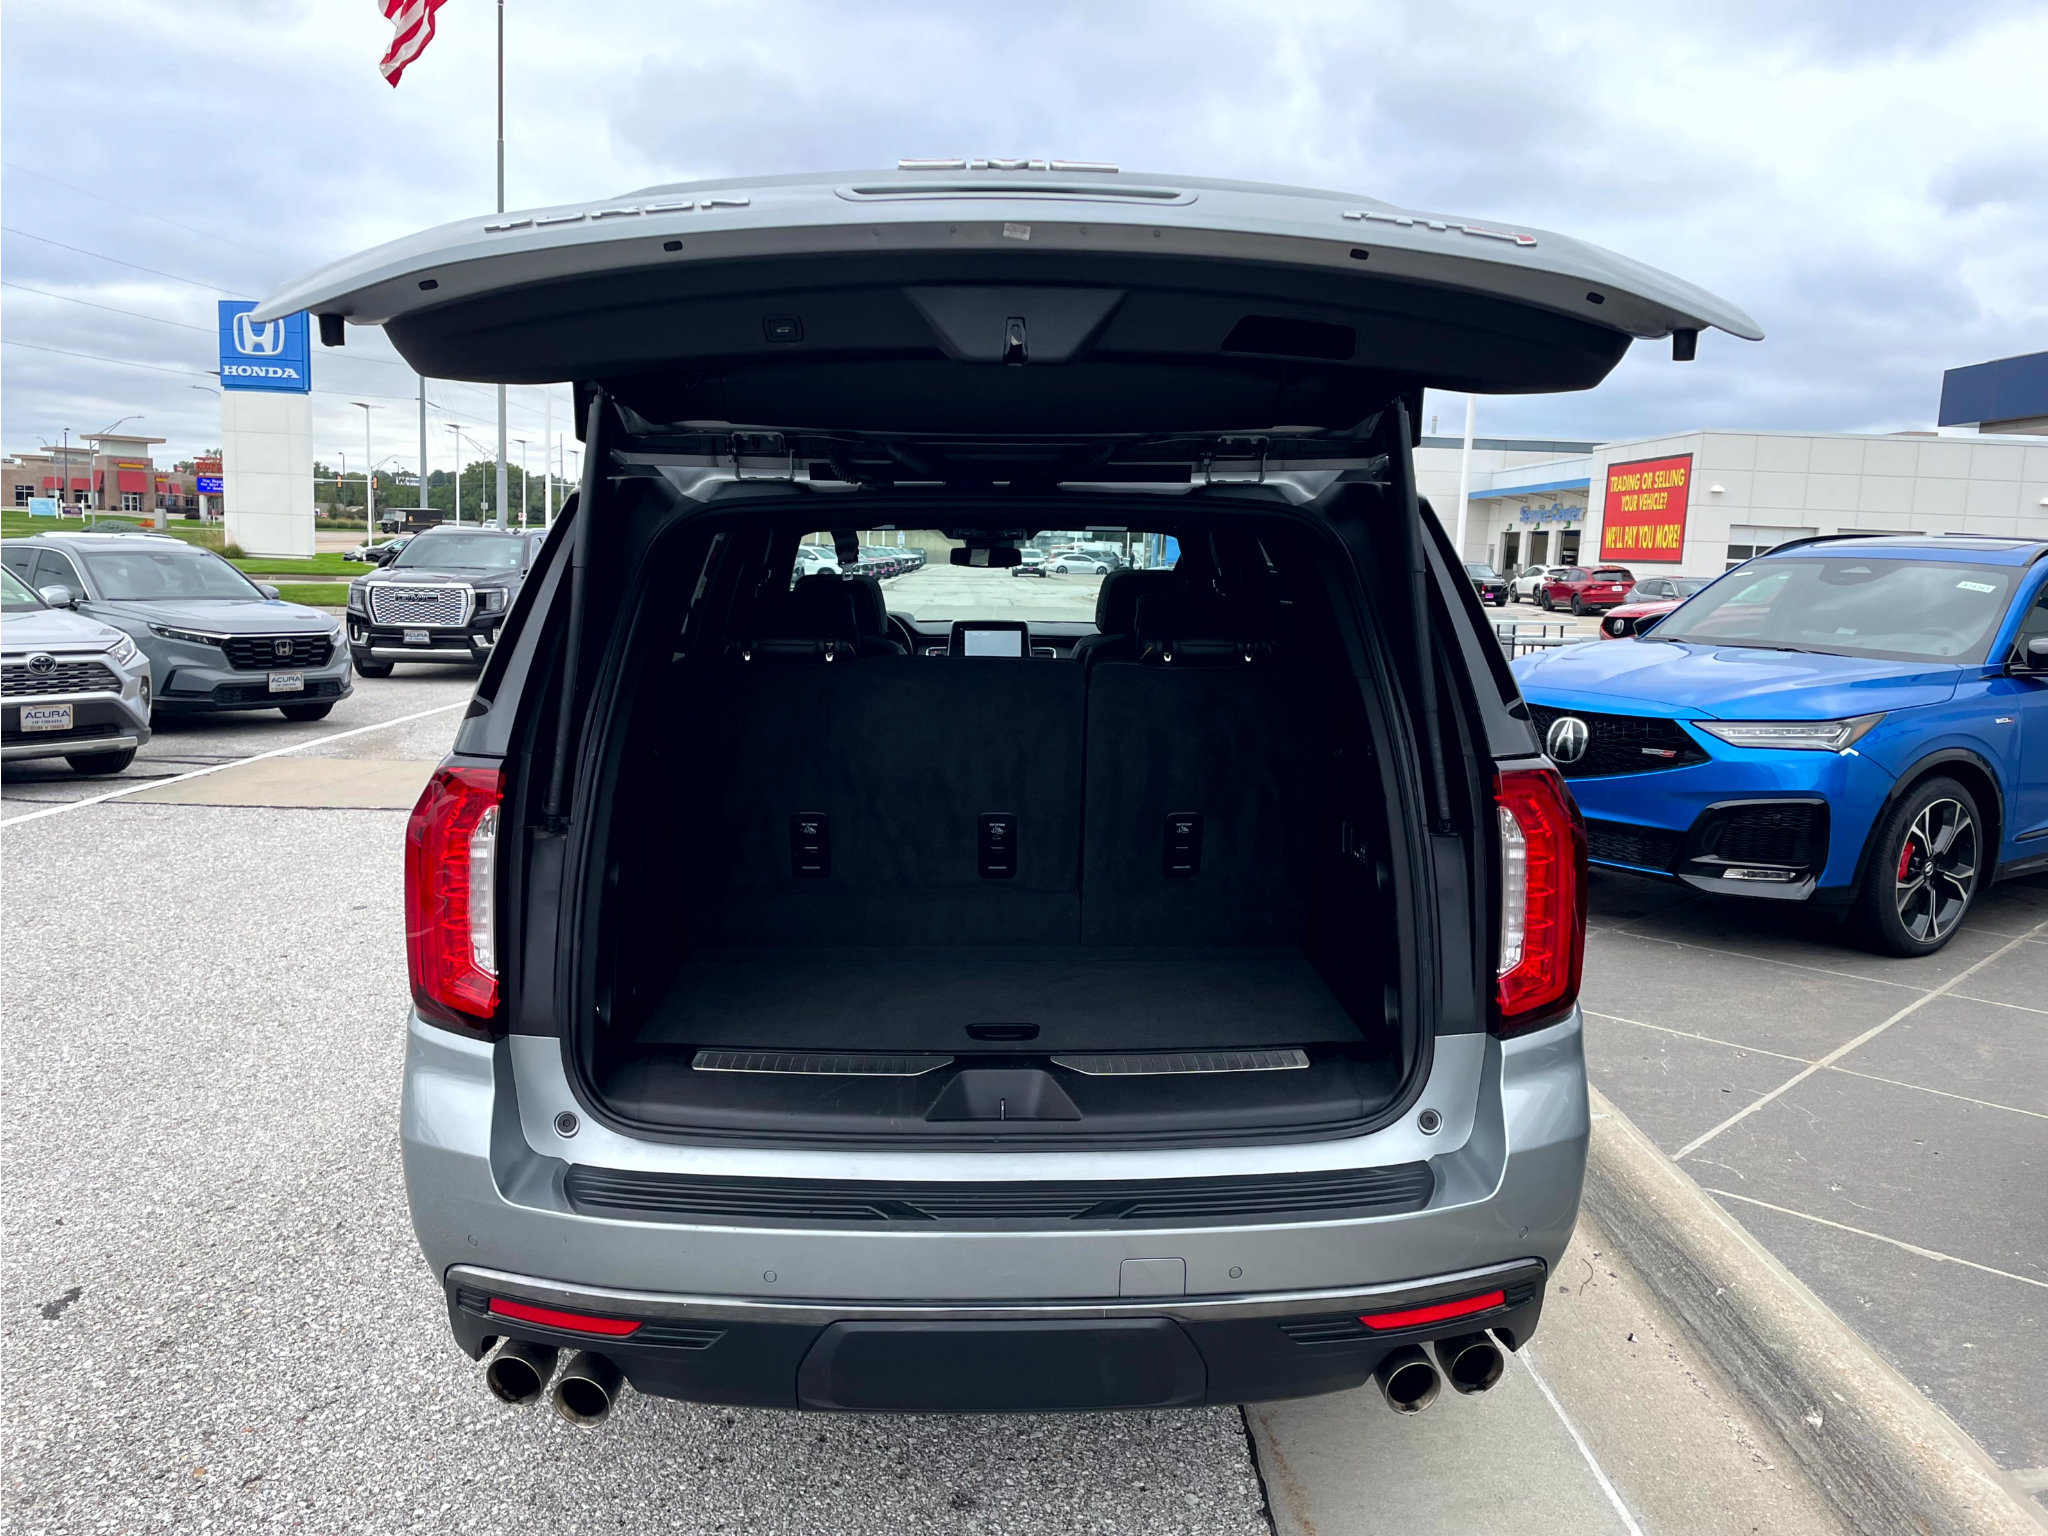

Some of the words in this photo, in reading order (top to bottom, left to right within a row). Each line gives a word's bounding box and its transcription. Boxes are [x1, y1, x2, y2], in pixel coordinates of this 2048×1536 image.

[222, 365, 300, 379] HONDA
[1610, 473, 1640, 492] TRADING
[1641, 472, 1653, 490] OR
[1654, 468, 1685, 489] SELLING
[1621, 494, 1638, 512] YOUR
[1639, 492, 1668, 511] VEHICLE?
[1520, 505, 1551, 522] Service
[1551, 503, 1586, 521] Center
[1605, 526, 1623, 549] WE'LL
[1623, 525, 1638, 549] PAY
[1638, 524, 1655, 549] YOU
[1655, 524, 1681, 549] MORE!
[394, 592, 440, 603] GMC
[25, 710, 70, 719] ACURA
